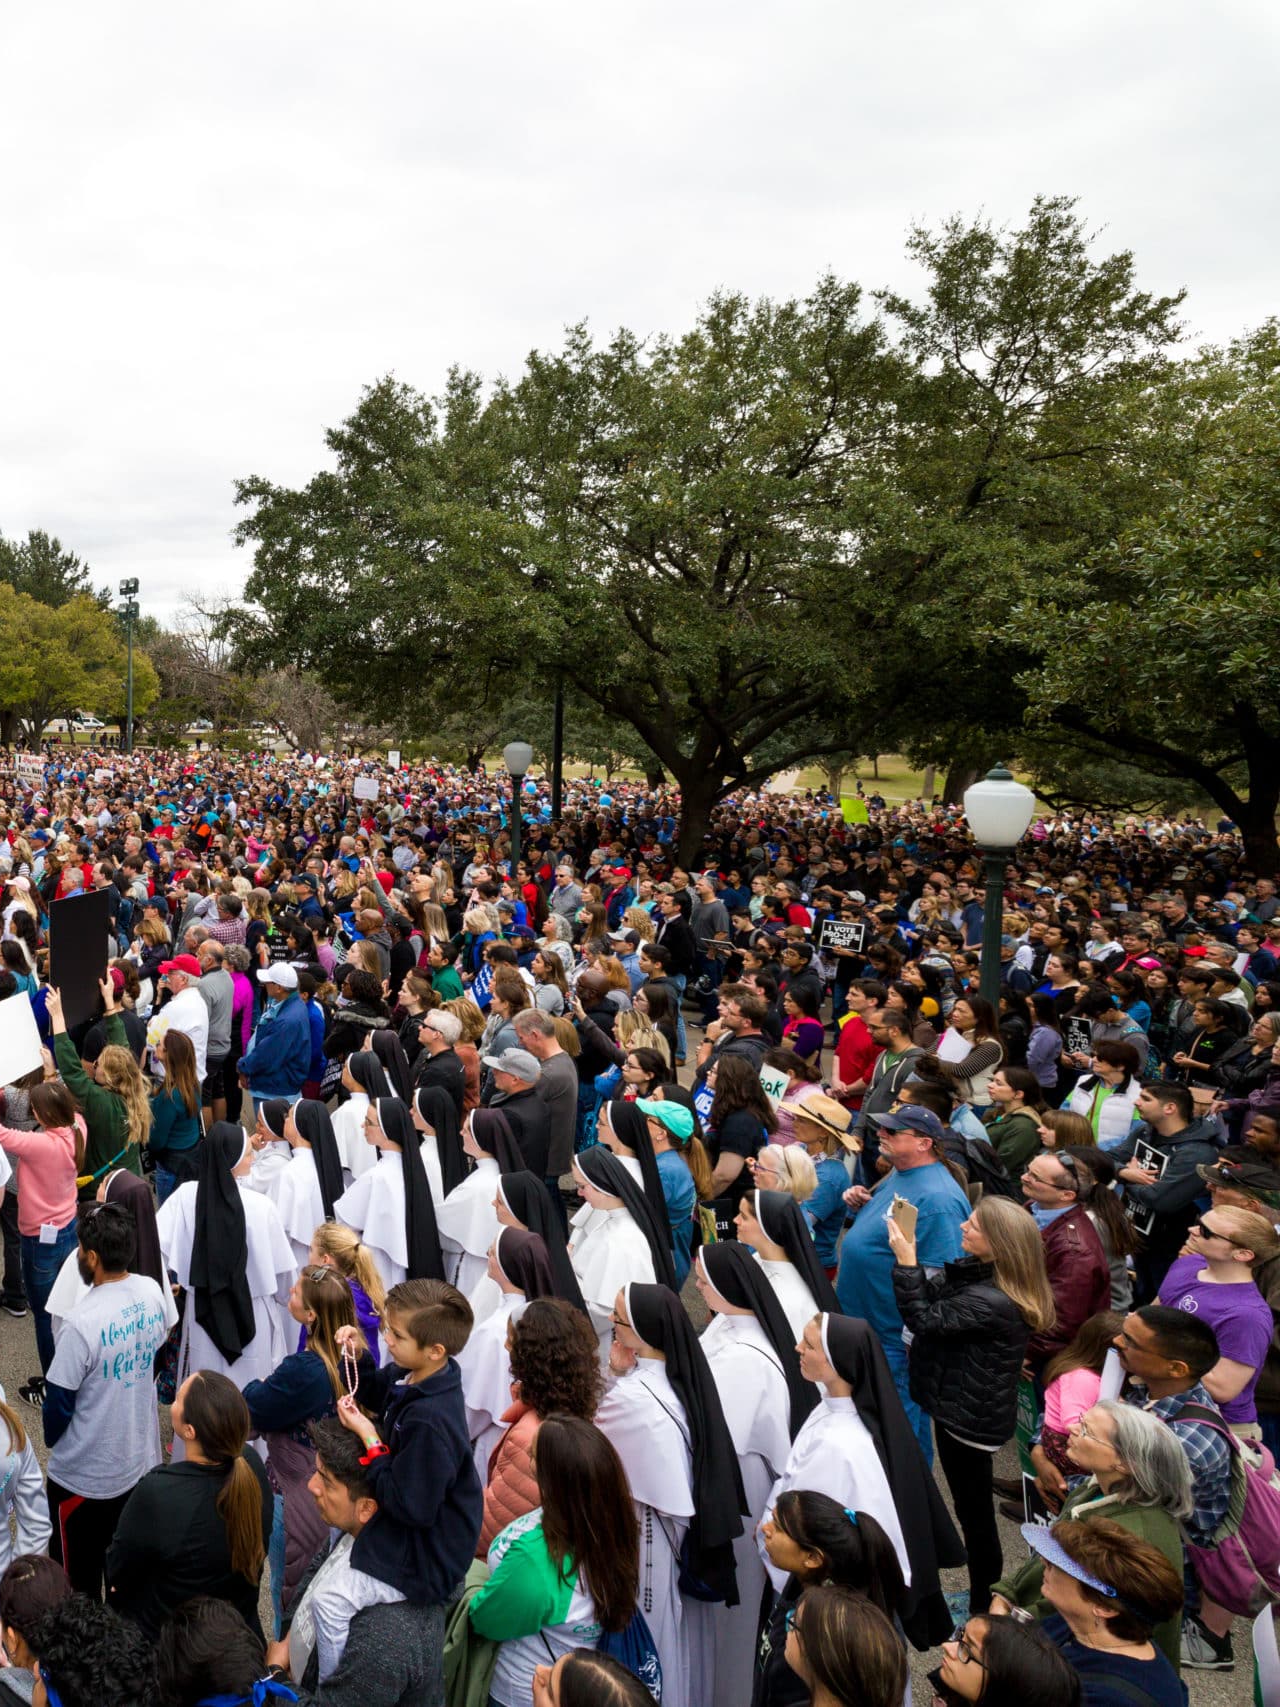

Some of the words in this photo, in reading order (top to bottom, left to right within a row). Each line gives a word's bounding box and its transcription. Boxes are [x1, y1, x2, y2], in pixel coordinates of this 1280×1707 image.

[834, 925, 856, 934] VOTE
[823, 930, 861, 941] PRO-LIFE
[830, 938, 851, 946] FIRST
